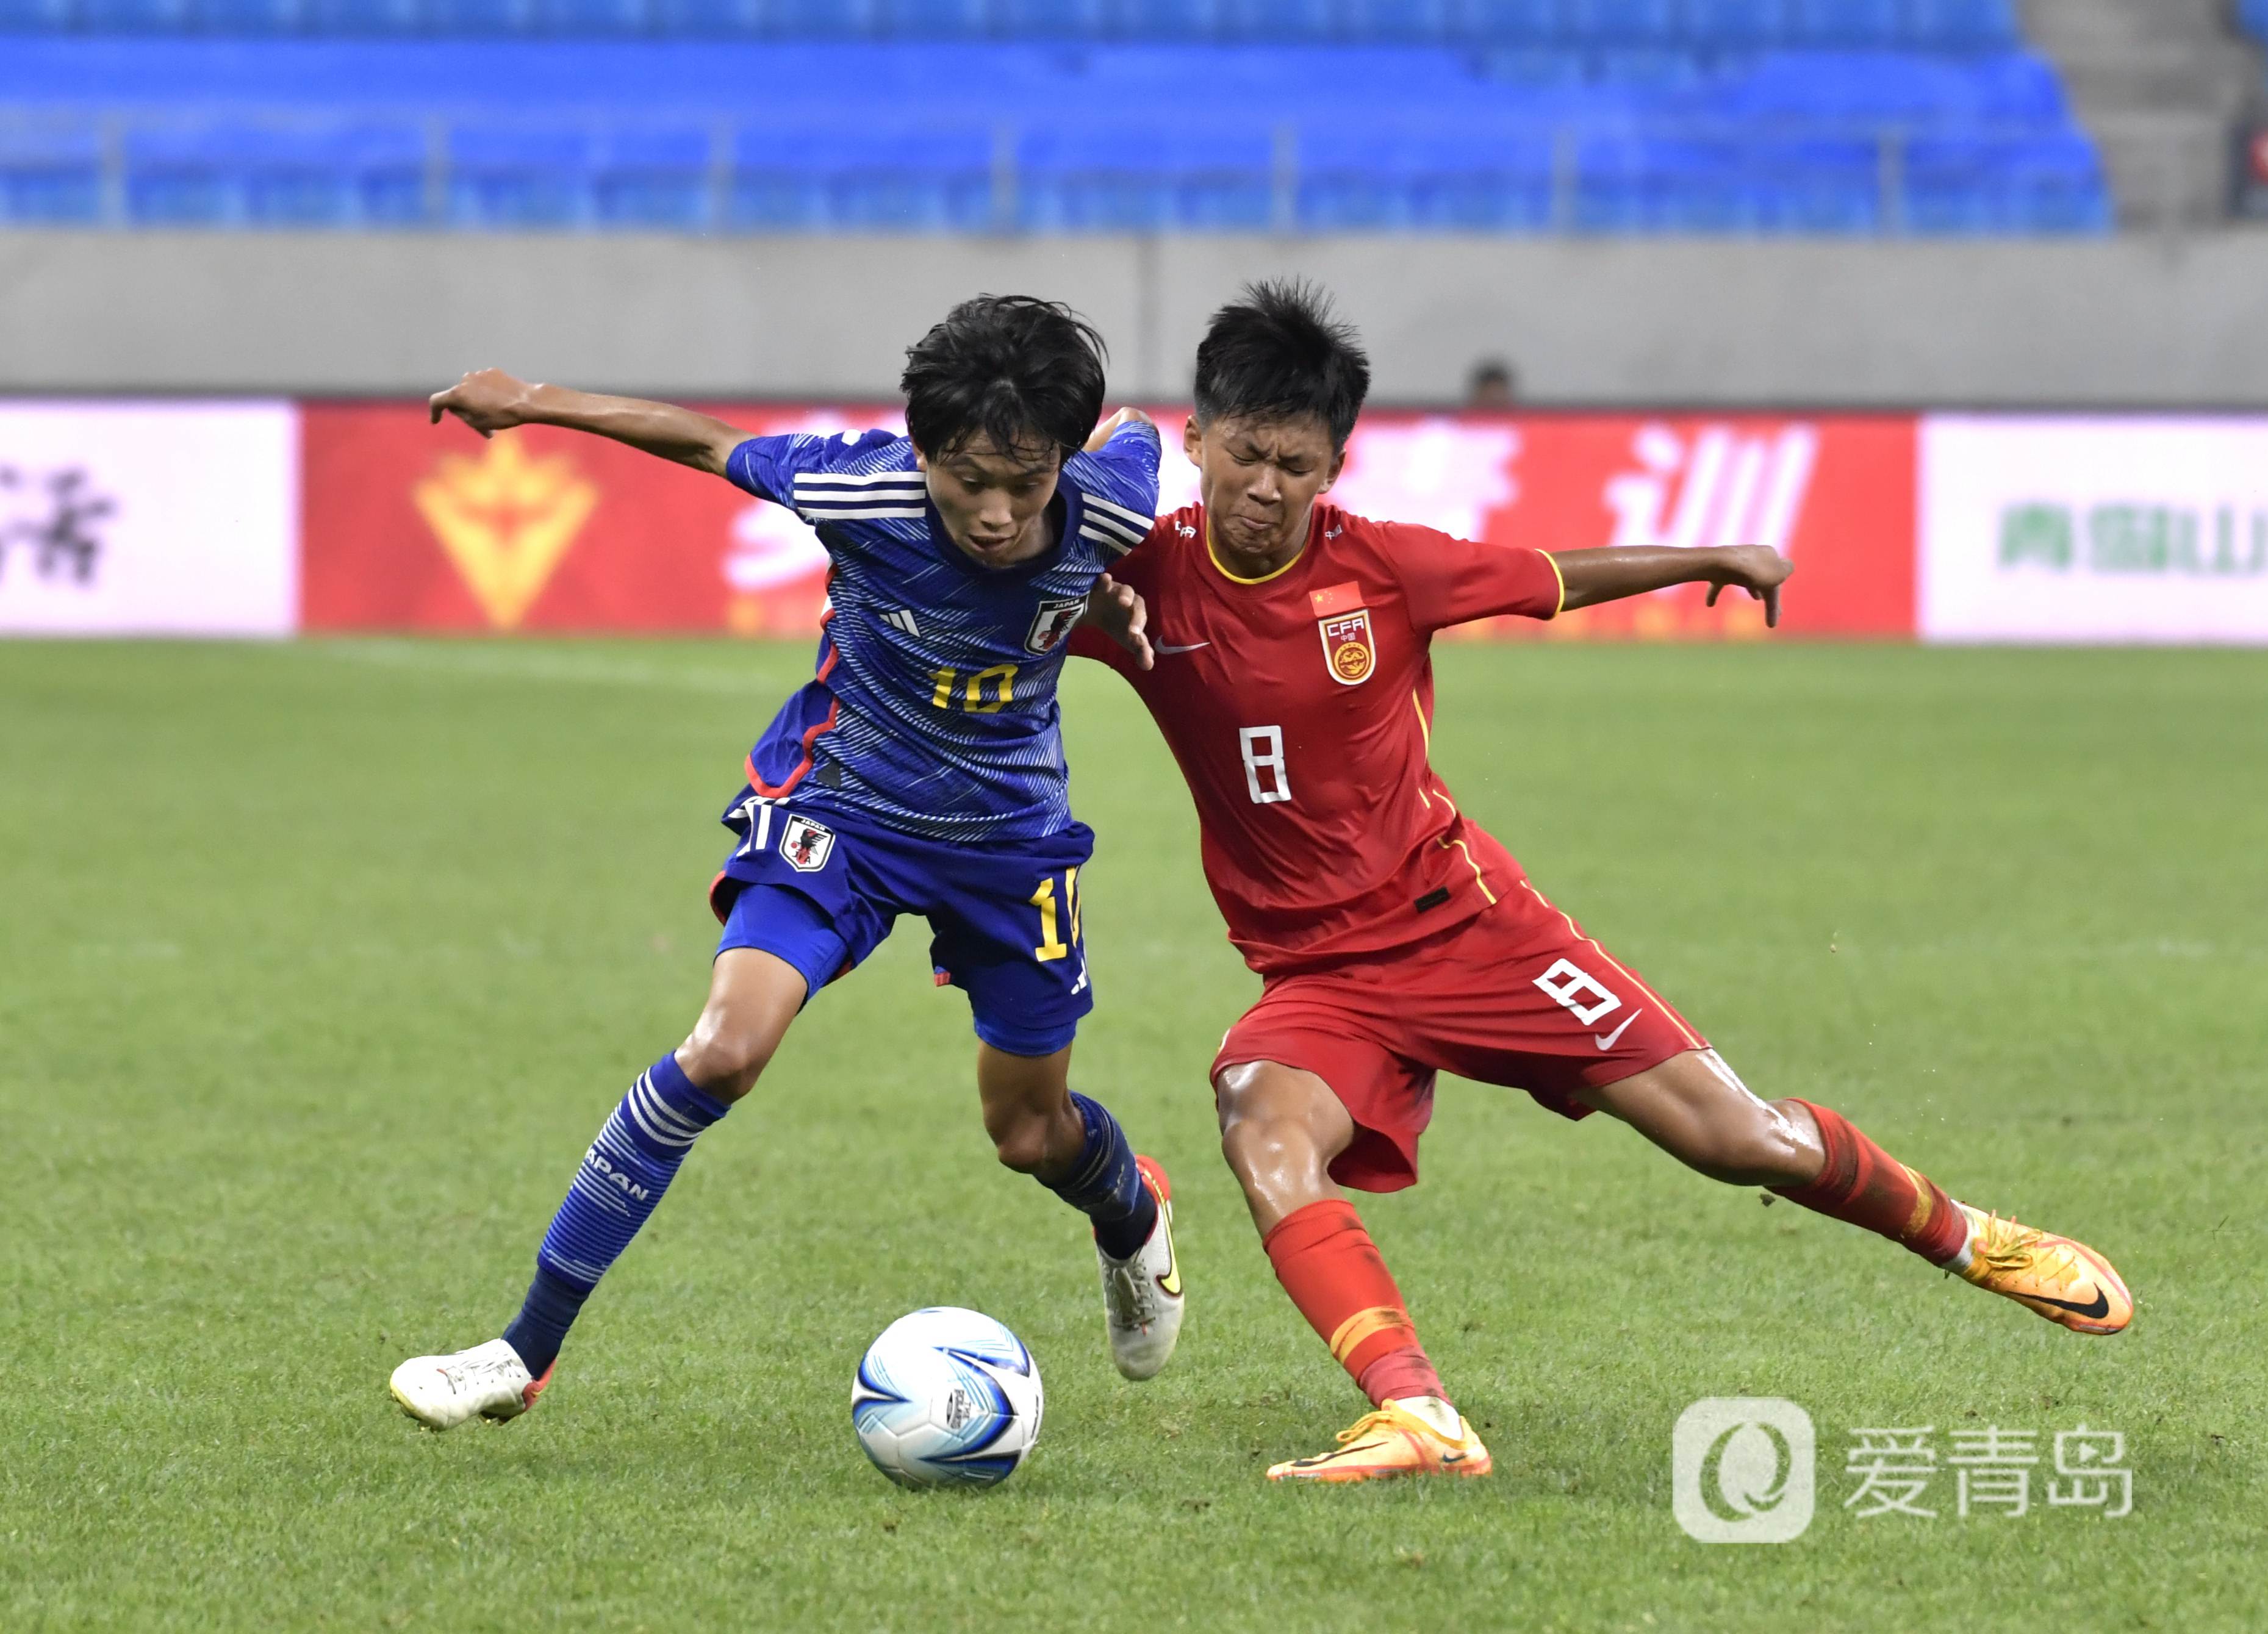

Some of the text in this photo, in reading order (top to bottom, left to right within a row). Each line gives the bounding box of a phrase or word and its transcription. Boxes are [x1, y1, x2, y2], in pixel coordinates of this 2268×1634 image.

[1053, 598, 1080, 609] JAPAN
[1327, 618, 1365, 637] CFA
[1341, 632, 1356, 642] 中国
[927, 664, 1019, 713] 10
[1239, 725, 1292, 804] 8
[800, 819, 825, 831] JAPAN
[1532, 958, 1622, 1026] 8
[585, 1145, 650, 1201] APAN
